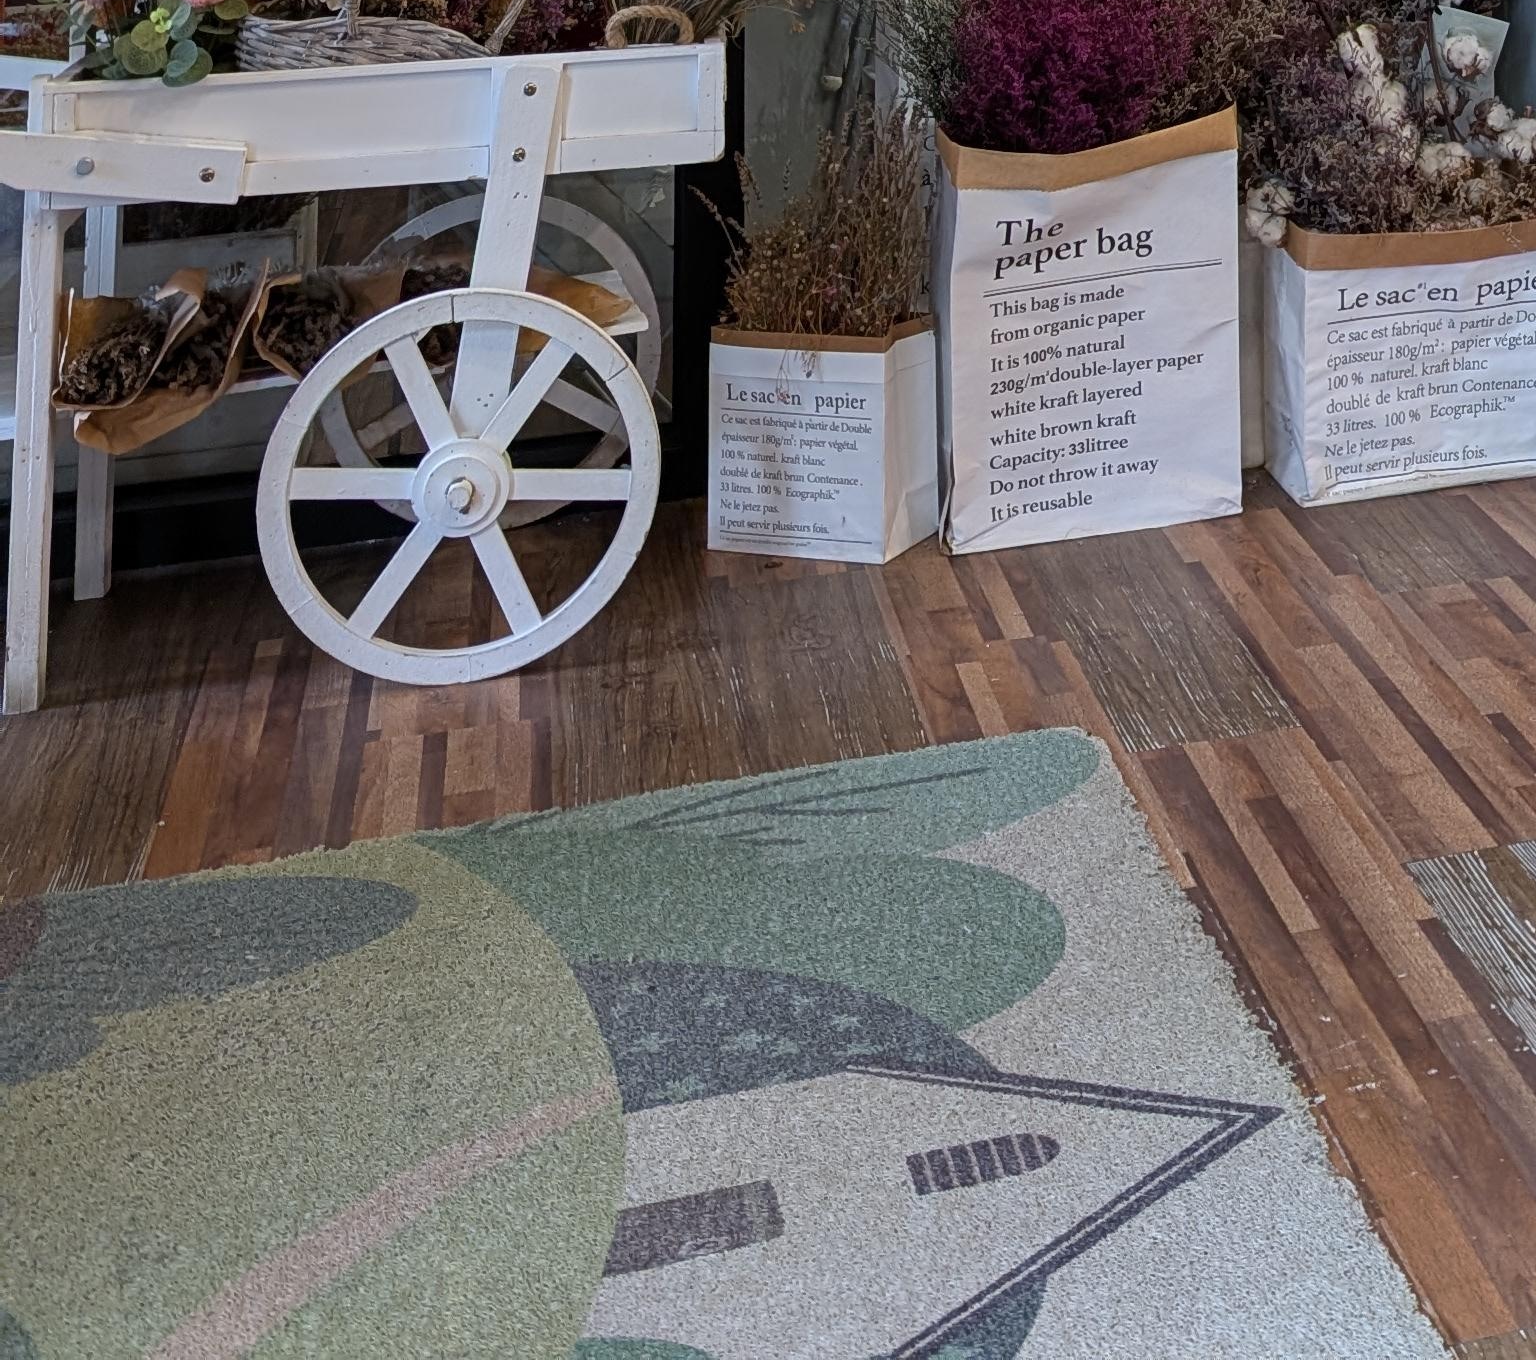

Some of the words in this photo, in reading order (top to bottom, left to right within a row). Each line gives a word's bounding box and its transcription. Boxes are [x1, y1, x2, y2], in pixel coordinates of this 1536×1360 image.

[995, 218, 1063, 246] The
[994, 240, 1087, 280] paper
[1096, 228, 1153, 257] bag
[990, 300, 1026, 317] This
[1031, 297, 1060, 312] bag
[1064, 292, 1076, 306] is
[1080, 284, 1124, 303] made
[1338, 288, 1368, 311] Le
[1376, 287, 1416, 306] sac
[1428, 288, 1458, 301] en
[991, 328, 1029, 344] from
[1034, 314, 1094, 336] organic
[1098, 310, 1145, 329] paper
[1327, 330, 1345, 344] Ce
[1348, 331, 1368, 342] sac
[1371, 326, 1388, 339] est
[1392, 318, 1442, 337] fabriqué
[1460, 316, 1495, 333] partir
[1498, 312, 1513, 326] de
[991, 358, 1003, 372] It
[1008, 355, 1019, 369] is
[1023, 345, 1062, 365] 100%
[1066, 335, 1124, 357] natural
[1157, 354, 1204, 372] paper
[1327, 350, 1384, 371] épaisseur
[1450, 335, 1491, 355] papier
[1371, 364, 1418, 383] naturel.
[1422, 358, 1450, 376] kraft
[1453, 356, 1488, 371] blanc
[726, 383, 748, 401] Le
[751, 390, 775, 403] sac
[815, 393, 866, 414] papier
[991, 400, 1035, 418] white
[1040, 390, 1078, 410] kraft
[1082, 381, 1142, 405] layered
[1326, 394, 1370, 414] doublé
[1376, 390, 1390, 405] de
[1397, 384, 1425, 401] kraft
[1428, 383, 1458, 396] brun
[722, 414, 733, 423] Ce
[763, 416, 797, 431] fabriqué
[805, 418, 828, 432] partir
[829, 421, 840, 432] de
[841, 422, 872, 434] Double
[990, 428, 1036, 446] white
[1040, 420, 1092, 438] brown
[1097, 410, 1136, 428] kraft
[1326, 422, 1340, 437] 33
[1343, 419, 1376, 432] litres.
[722, 432, 759, 444] épaisseur
[800, 438, 826, 450] papier
[990, 448, 1064, 471] Capacity:
[1069, 438, 1128, 455] 33litree
[1324, 444, 1343, 457] Ne
[1347, 440, 1356, 454] le
[1359, 438, 1388, 456] jetez
[1391, 436, 1415, 451] pas.
[720, 466, 748, 478] doublé
[751, 468, 761, 478] de
[763, 468, 782, 480] kraft
[784, 471, 804, 482] brun
[781, 453, 800, 464] kraft
[802, 455, 825, 466] blanc
[1324, 464, 1332, 480] Il
[1335, 463, 1362, 481] peut
[1366, 456, 1400, 472] servir
[1404, 450, 1459, 471] plusieurs
[1462, 445, 1487, 464] fois.
[720, 482, 729, 492] 33
[990, 480, 1014, 495] Do
[1018, 474, 1045, 489] not
[1049, 468, 1097, 484] throw
[1102, 462, 1113, 476] it
[1117, 460, 1158, 474] away
[720, 498, 732, 509] Ne
[734, 500, 740, 510] le
[742, 501, 761, 513] jetez
[992, 506, 1003, 522] It
[1007, 504, 1019, 520] is
[1023, 490, 1092, 514] reusable
[720, 516, 725, 525] Il
[727, 520, 745, 529] peut
[747, 520, 770, 530] servir
[772, 520, 810, 533] plusieurs
